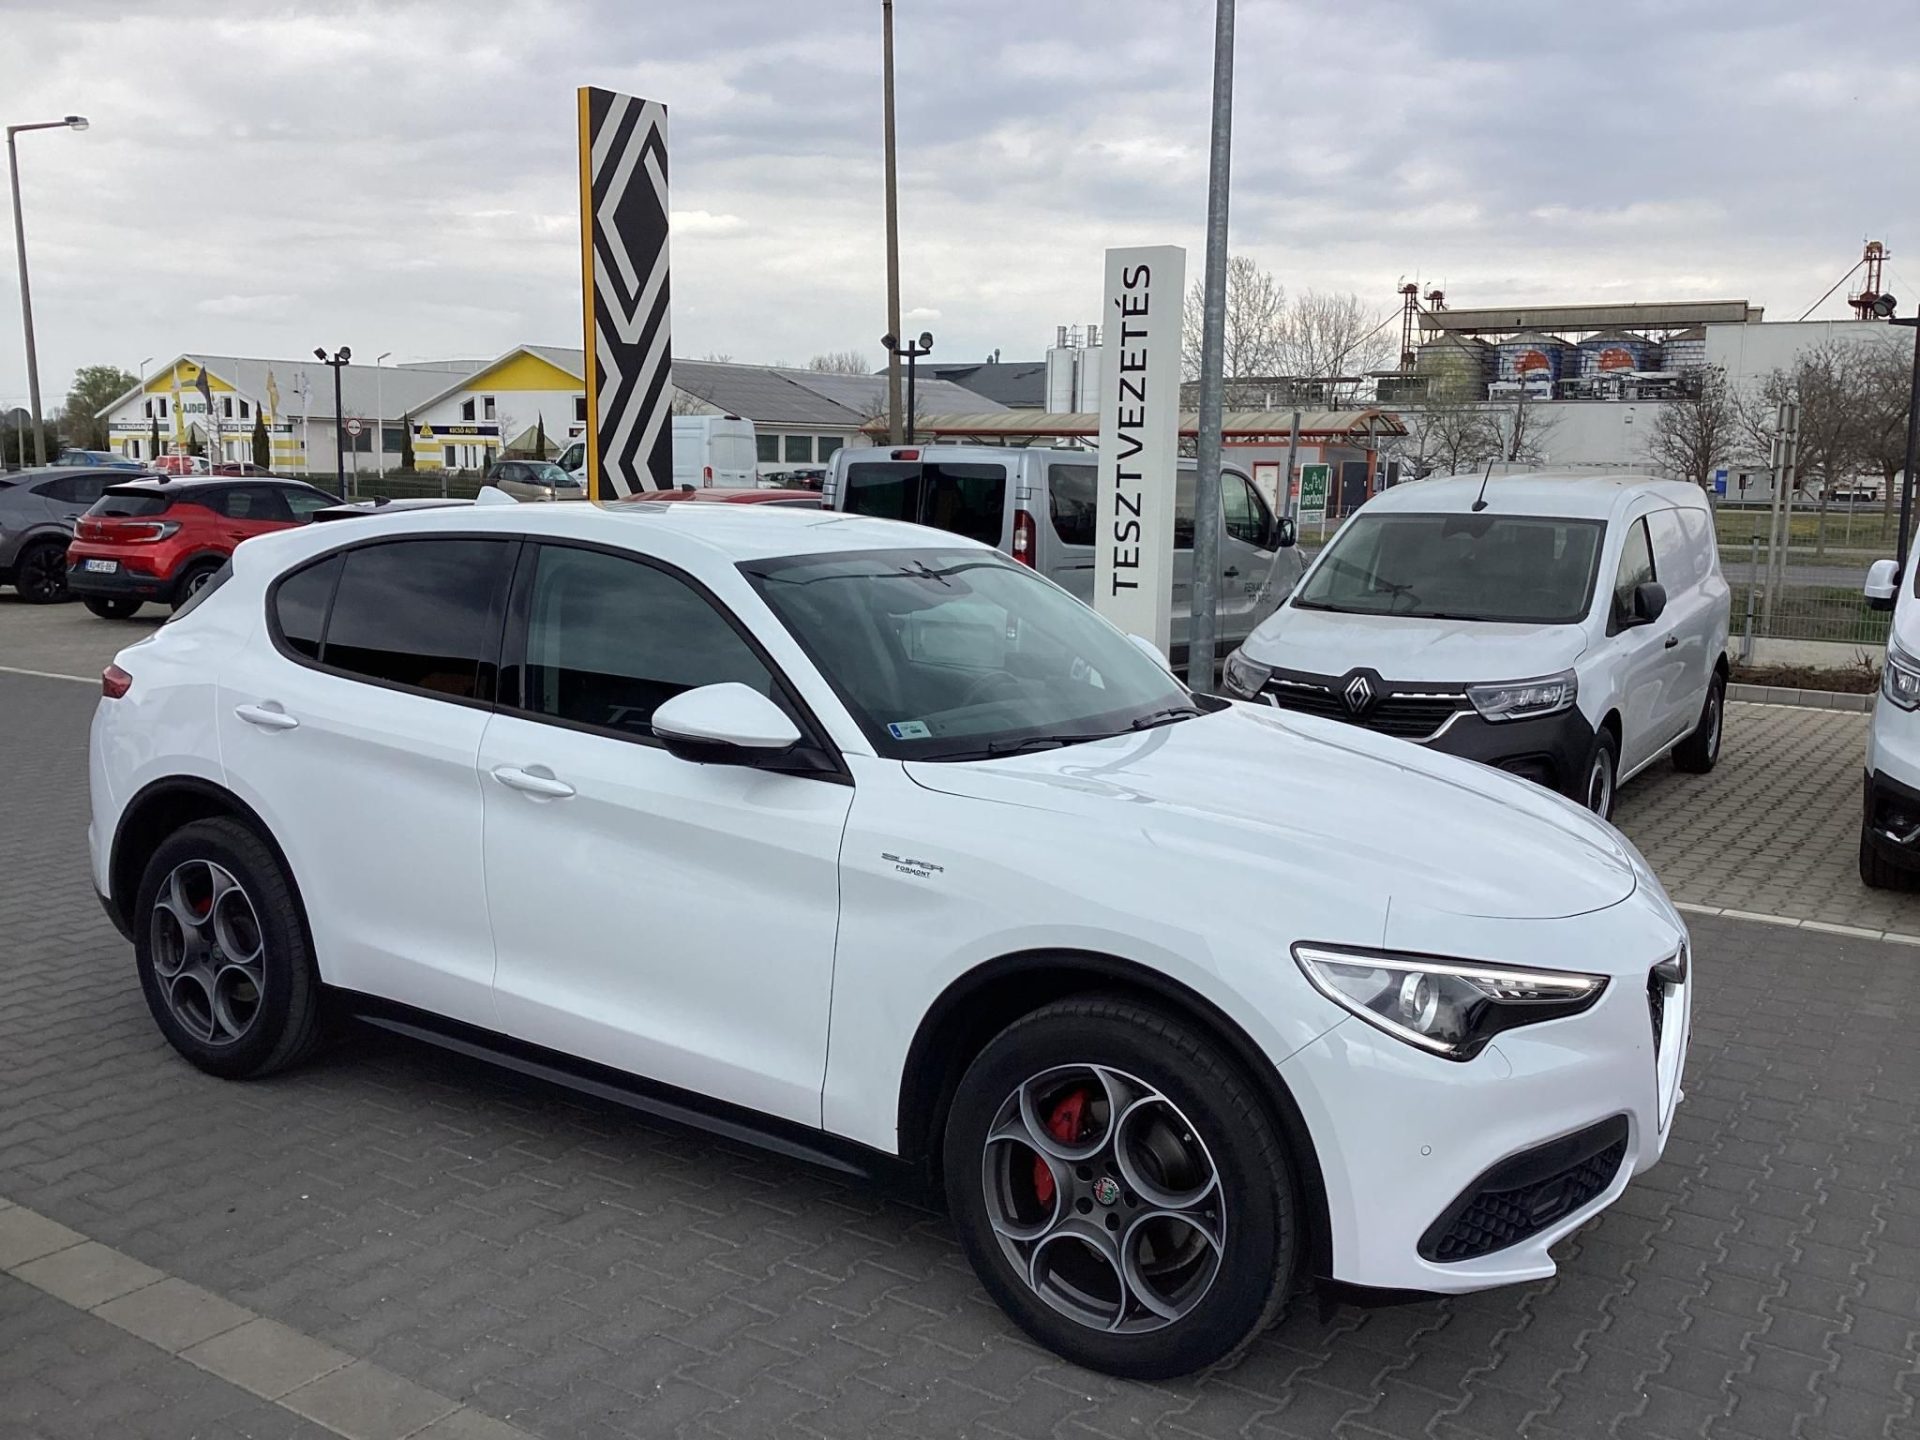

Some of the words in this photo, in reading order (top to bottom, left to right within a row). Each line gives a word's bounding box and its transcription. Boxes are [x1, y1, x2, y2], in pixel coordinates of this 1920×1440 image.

[1112, 264, 1151, 596] TESZTVEZETÉS
[881, 852, 944, 873] SUPER
[895, 864, 930, 878] FORMONT
